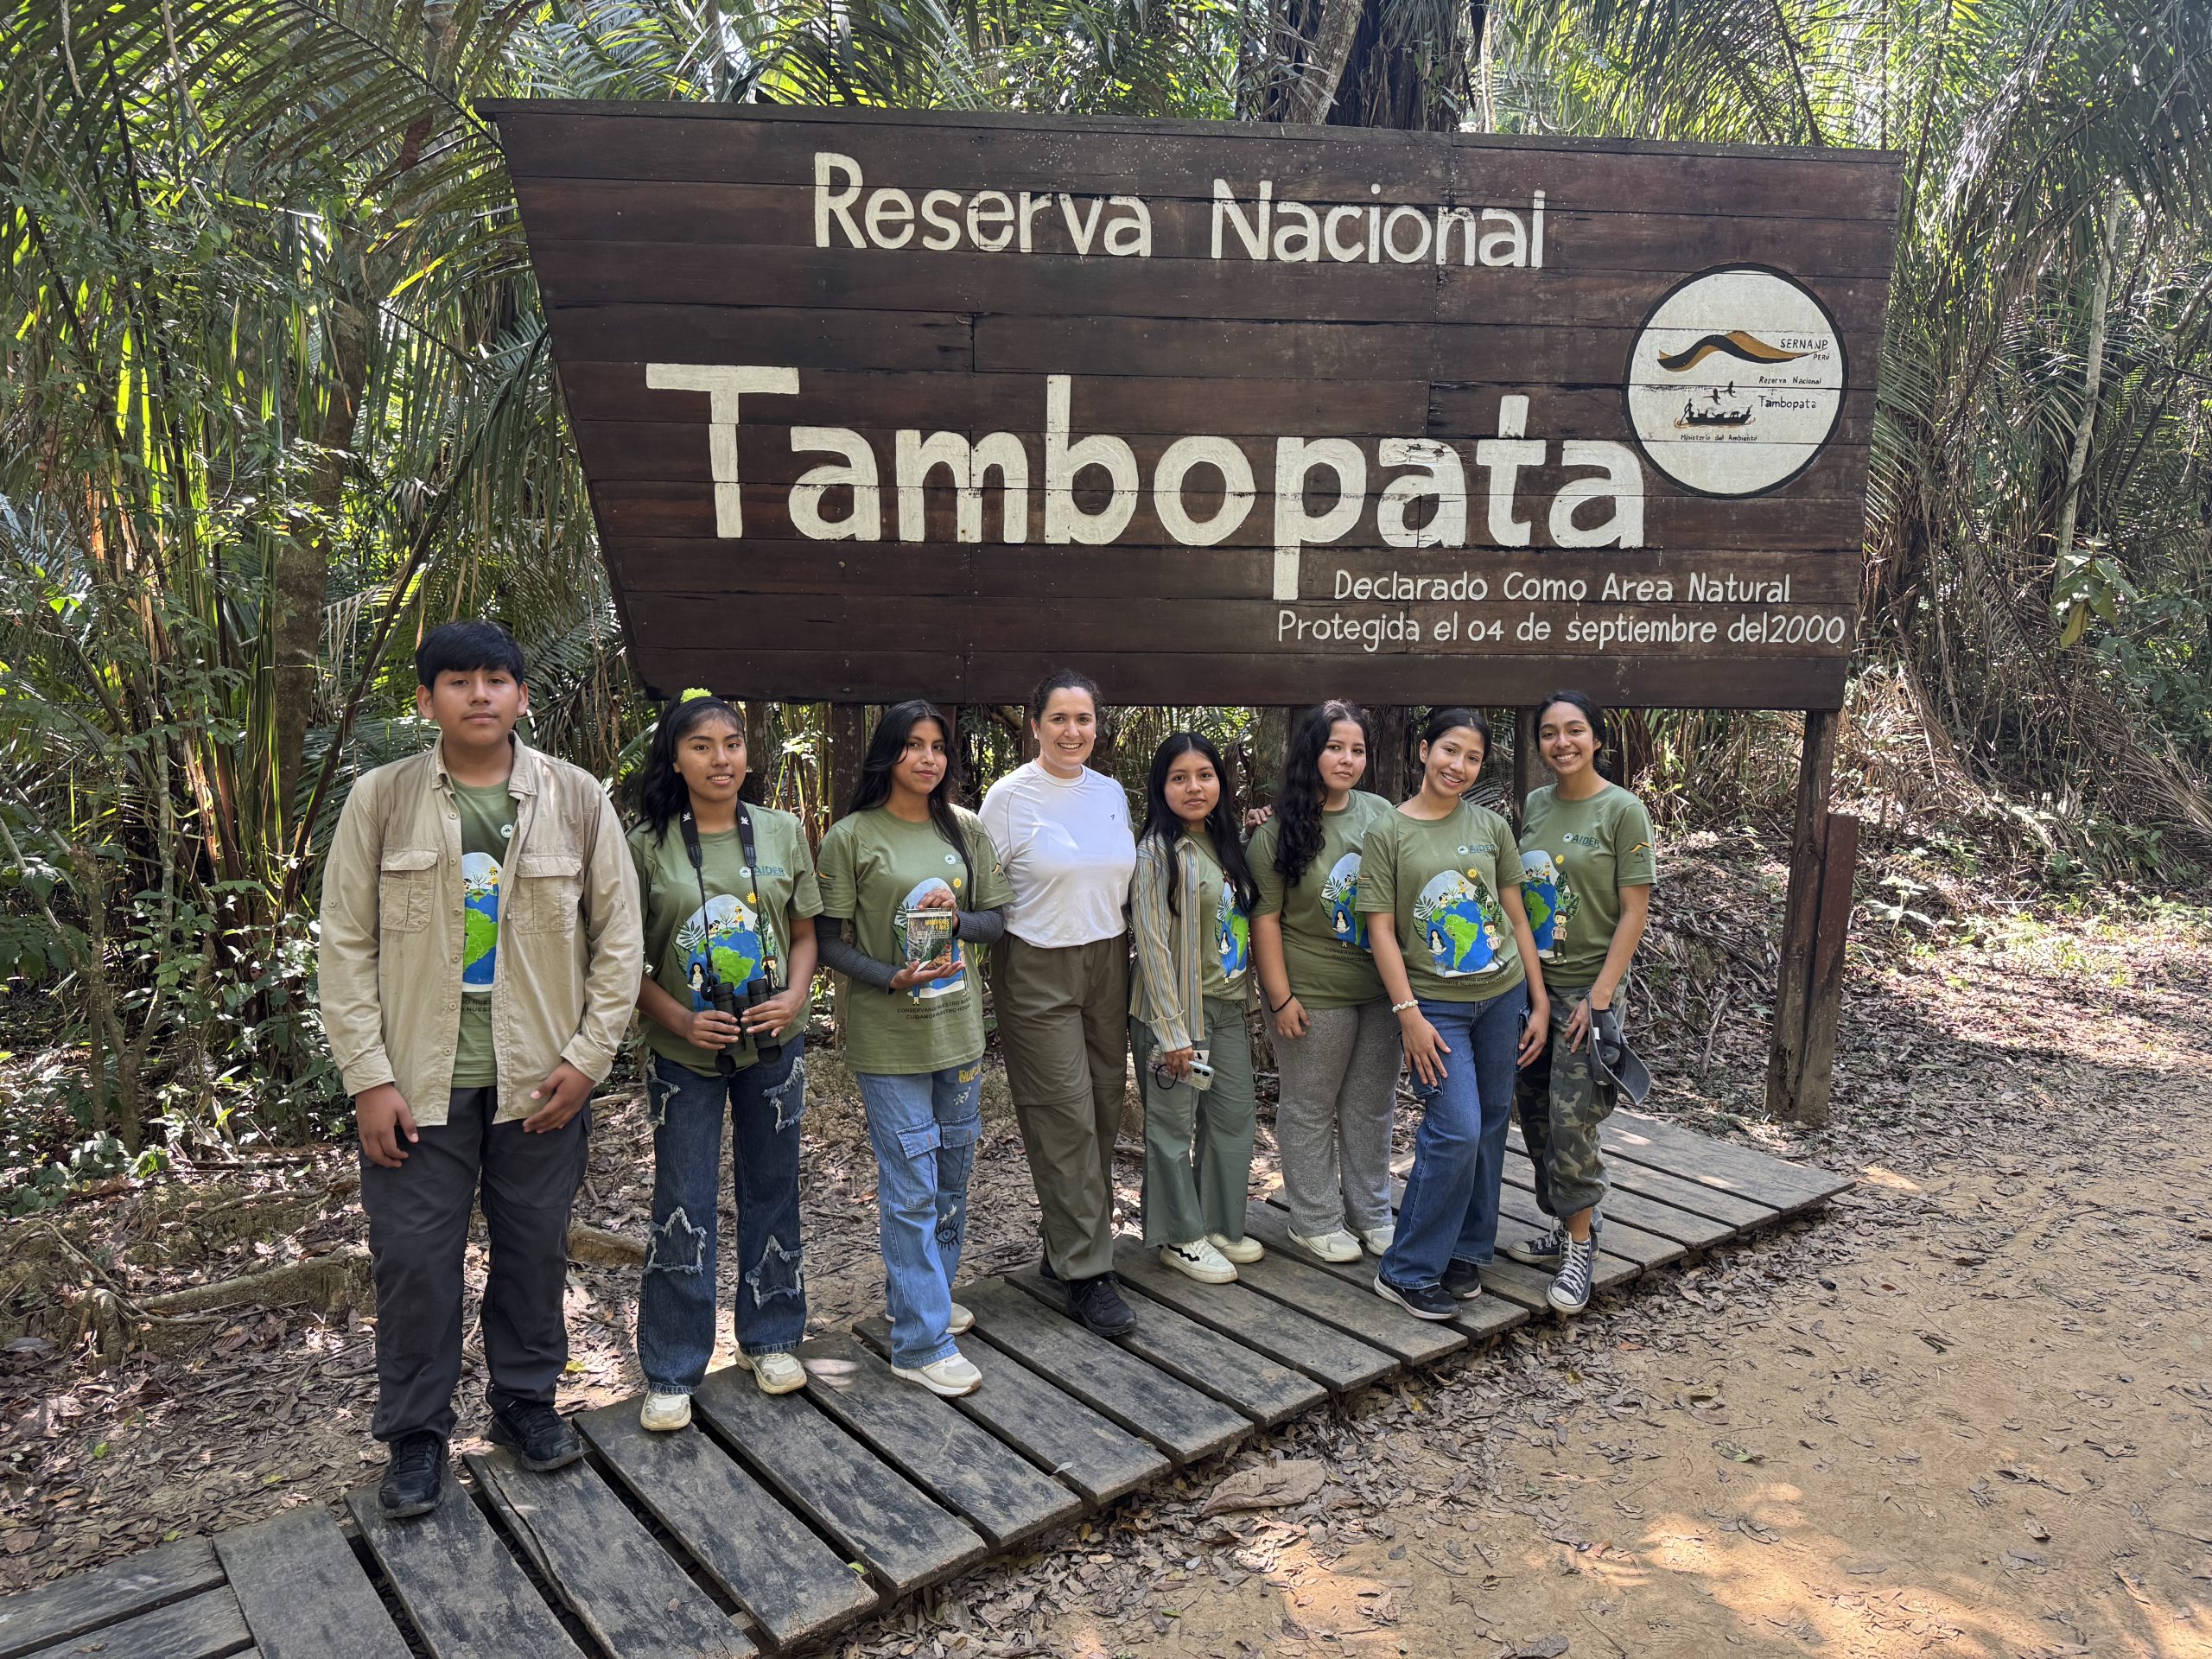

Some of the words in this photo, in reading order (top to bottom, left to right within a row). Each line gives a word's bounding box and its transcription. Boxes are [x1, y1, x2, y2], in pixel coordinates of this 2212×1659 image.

[815, 151, 1153, 257] Reserva
[1211, 178, 1548, 270] Nacional
[1780, 339, 1828, 350] SERNANP
[1758, 376, 1787, 385] Reserva
[1792, 376, 1821, 385] Nacional
[1758, 395, 1816, 410] Tambopata
[645, 363, 1646, 601] Tambopata
[1334, 569, 1488, 601] Declarado
[1503, 571, 1587, 601] Como
[1602, 573, 1674, 601] Area
[1688, 572, 1790, 603] Natural
[1279, 610, 1420, 652] Protegida
[1433, 611, 1459, 642] el
[1468, 620, 1504, 641] 04
[1517, 612, 1552, 642] de
[1566, 613, 1718, 652] septiembre
[1573, 834, 1599, 849] AIDER
[754, 866, 785, 876] AIDER
